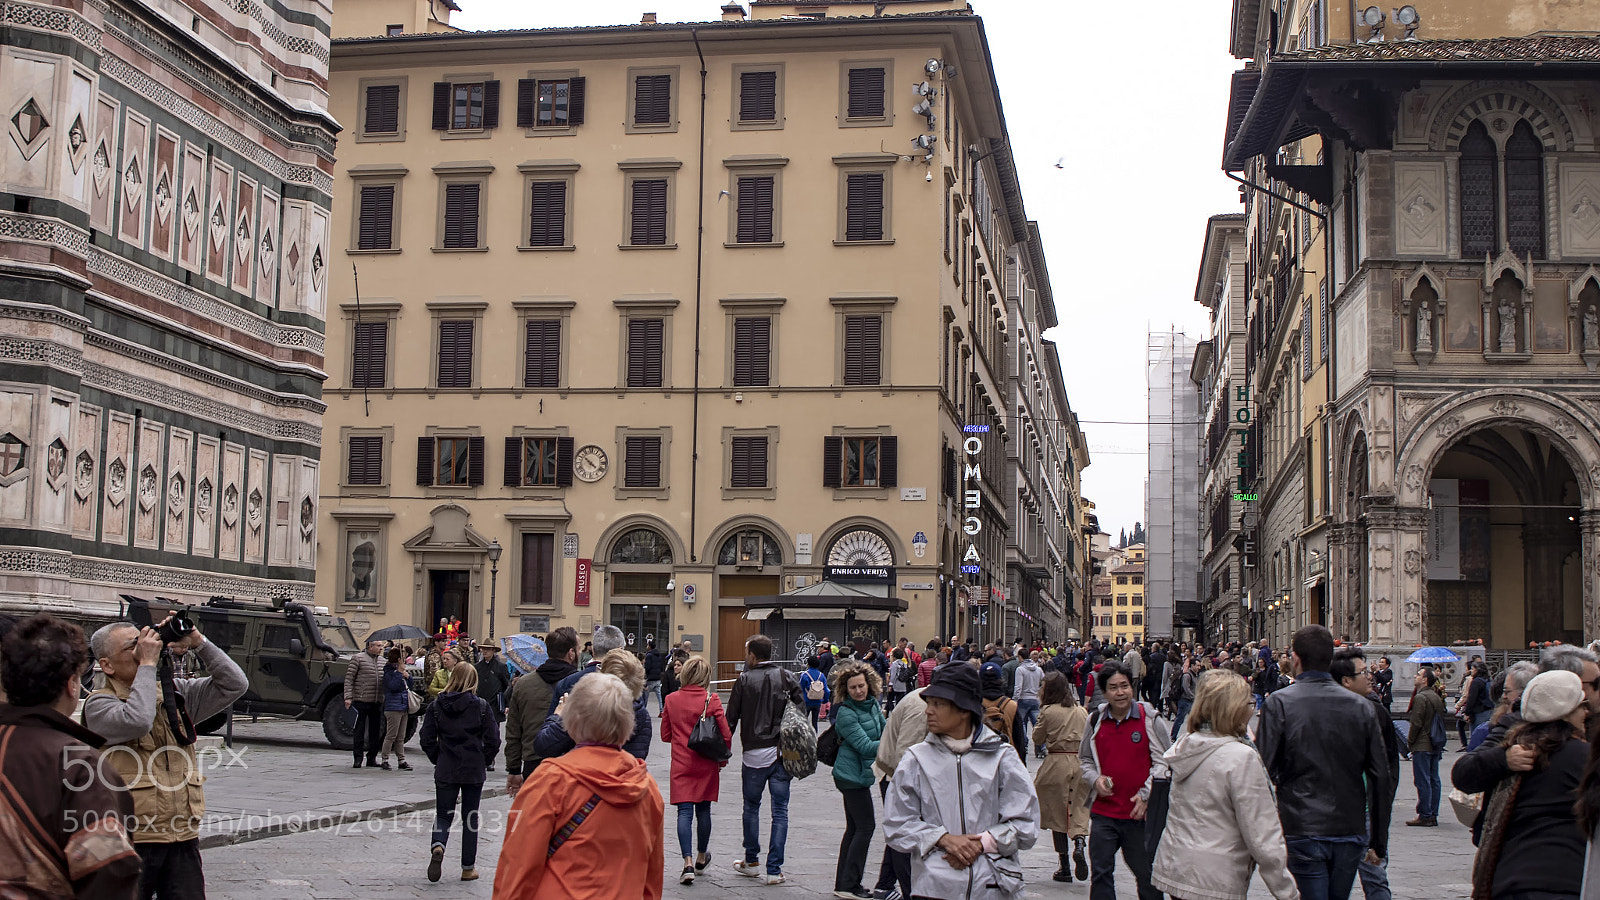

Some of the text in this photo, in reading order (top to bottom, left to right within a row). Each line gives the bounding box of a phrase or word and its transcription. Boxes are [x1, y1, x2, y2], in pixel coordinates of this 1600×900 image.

[1236, 385, 1250, 490] HOTEL
[1233, 493, 1258, 501] BIGALLO
[1243, 501, 1256, 567] HOTEL
[578, 563, 586, 593] MUSEO
